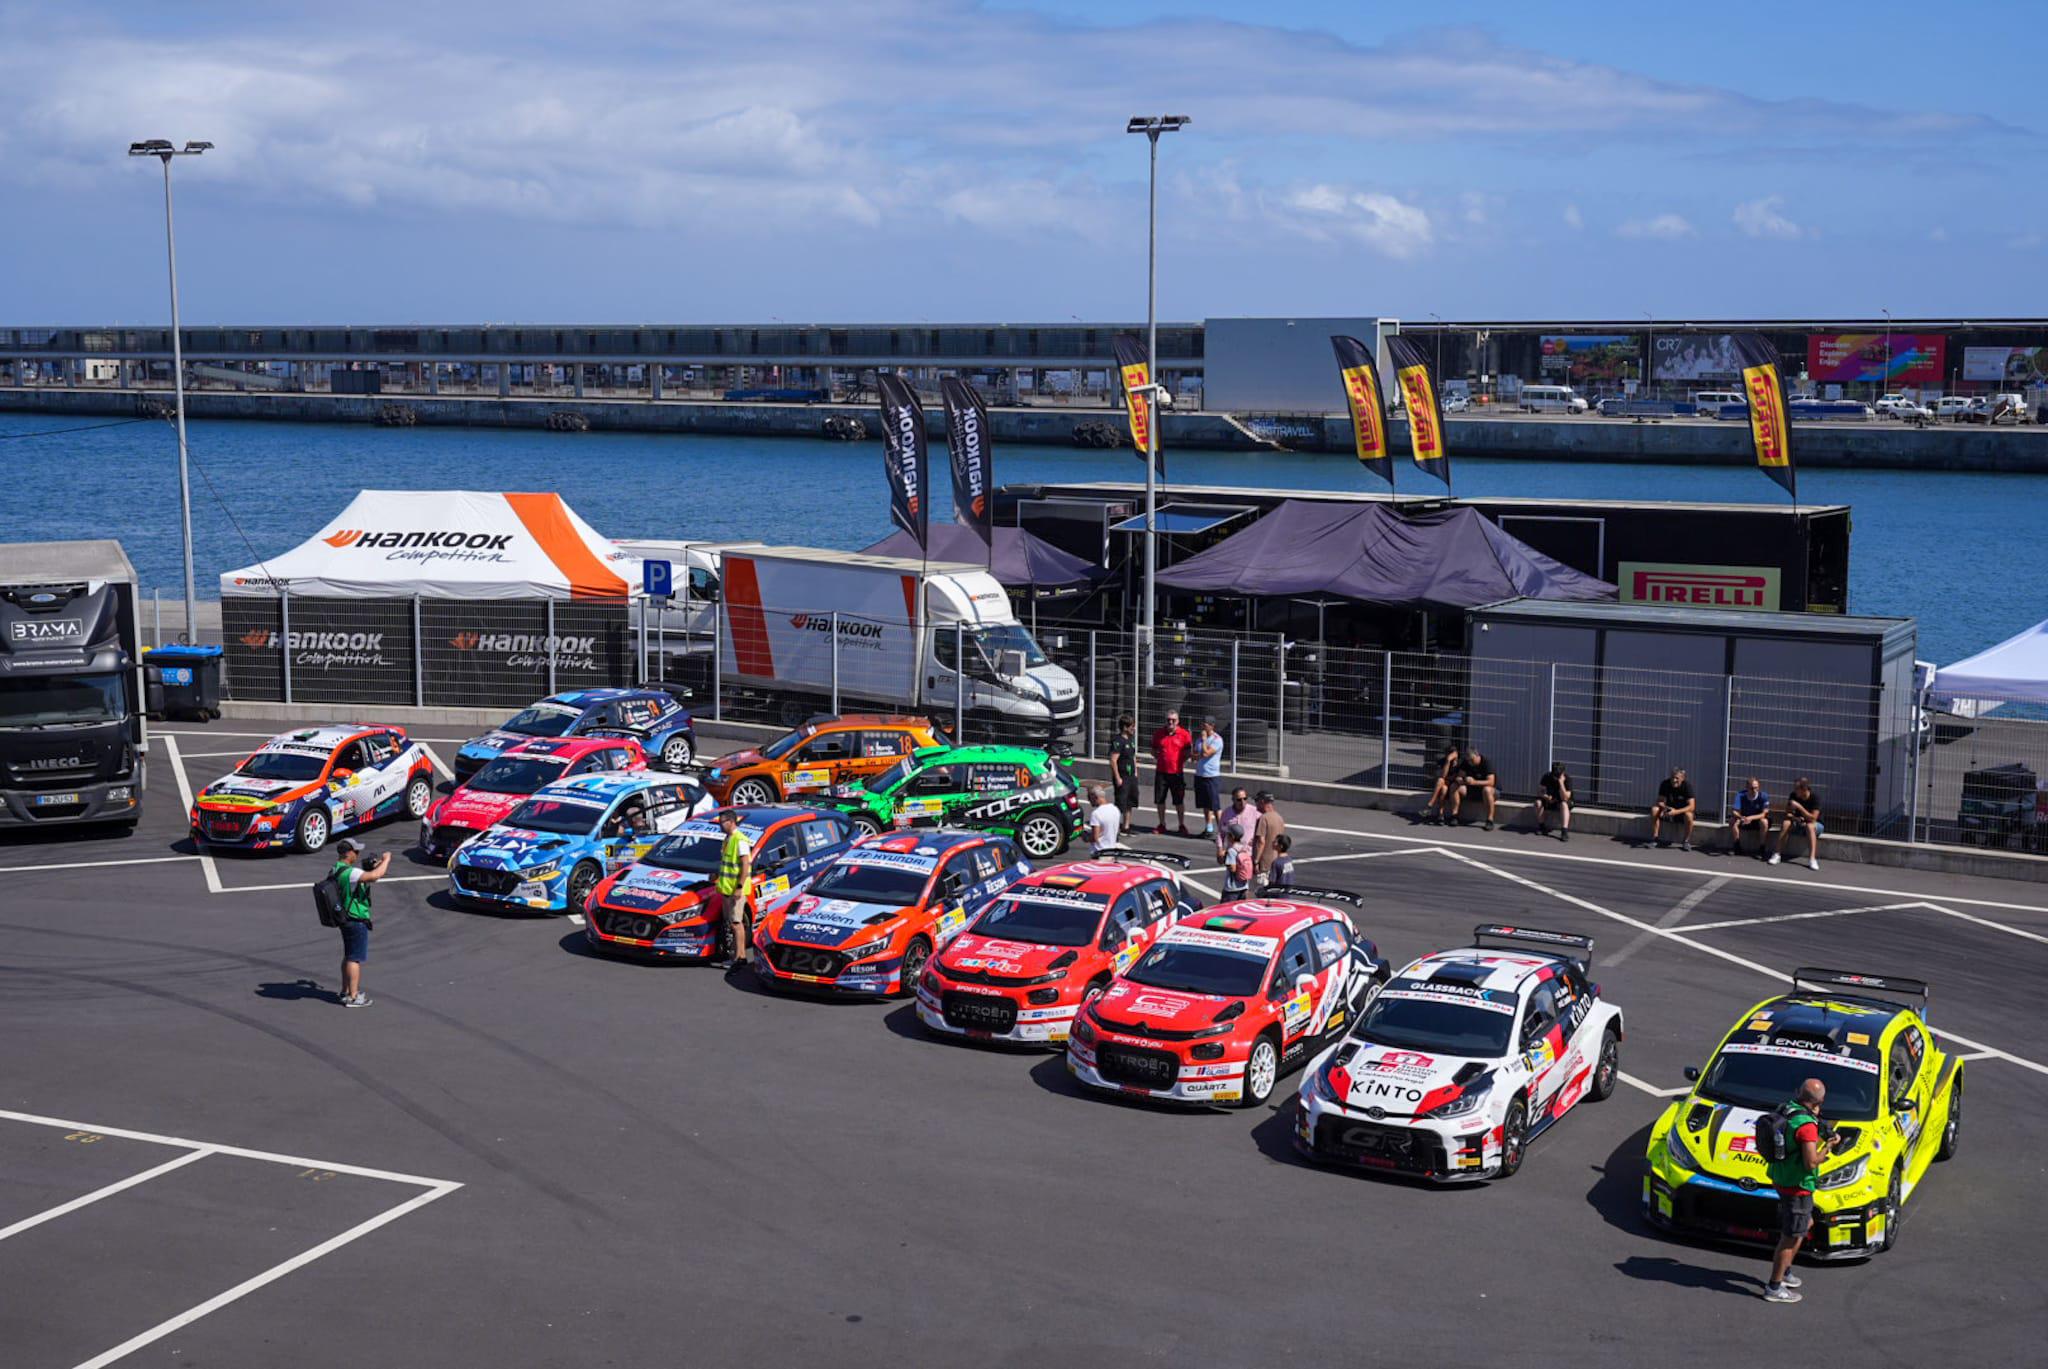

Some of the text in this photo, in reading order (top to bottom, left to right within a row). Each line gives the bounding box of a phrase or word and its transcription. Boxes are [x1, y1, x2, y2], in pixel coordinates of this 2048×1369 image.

[1656, 338, 1683, 351] CR7
[355, 532, 513, 549] HANKOOK
[386, 550, 516, 565] Competition
[650, 564, 666, 590] P
[1633, 571, 1766, 606] PIRELLI
[15, 622, 80, 637] BRAMA
[296, 651, 395, 670] Competition
[899, 735, 912, 754] 18
[30, 757, 80, 769] IVECO
[1015, 767, 1030, 788] 16
[873, 853, 927, 866] HYUNDAI
[1026, 886, 1087, 898] CITROËN
[1411, 982, 1487, 999] GLASSBACK
[1775, 1037, 1829, 1052] ENCIVIL
[1187, 1083, 1227, 1092] QUARTZ
[1342, 1127, 1413, 1152] GR
